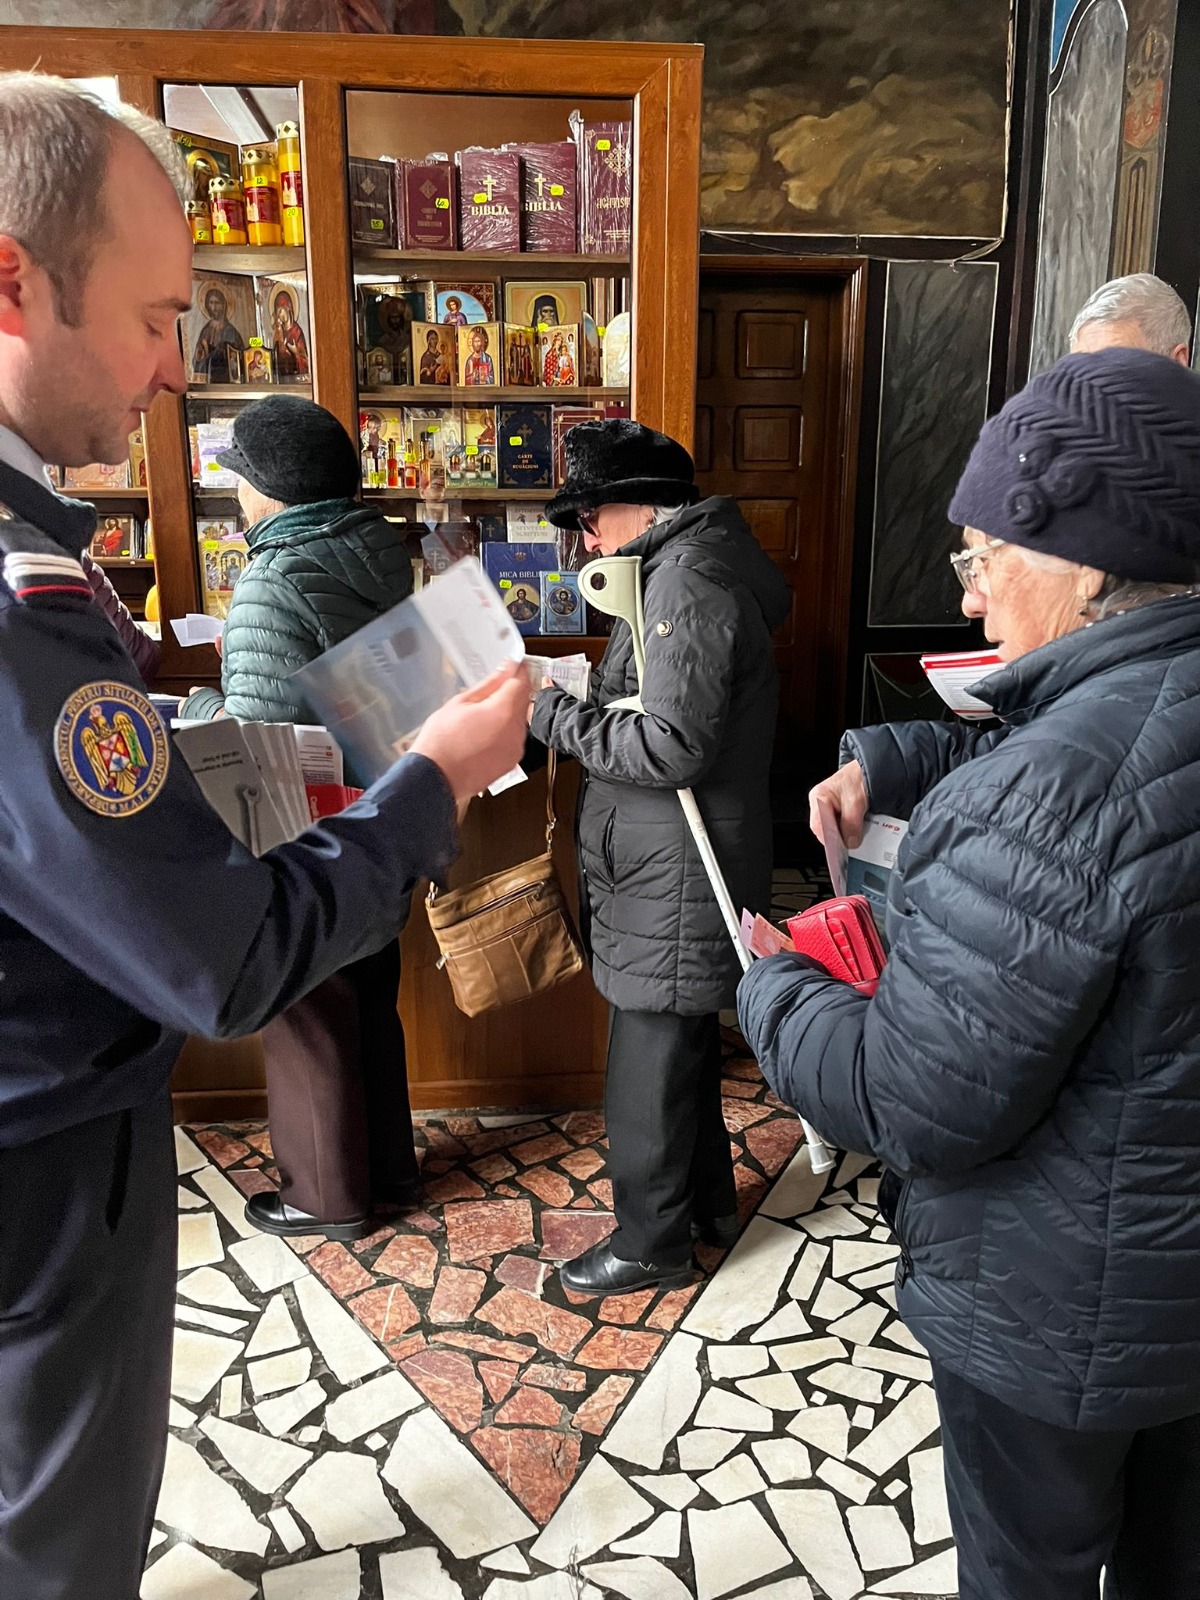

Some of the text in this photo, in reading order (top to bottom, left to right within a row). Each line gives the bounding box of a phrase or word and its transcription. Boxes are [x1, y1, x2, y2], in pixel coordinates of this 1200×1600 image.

[471, 204, 510, 216] BIBLIA
[499, 571, 518, 579] MICA
[519, 571, 545, 579] BIBLI
